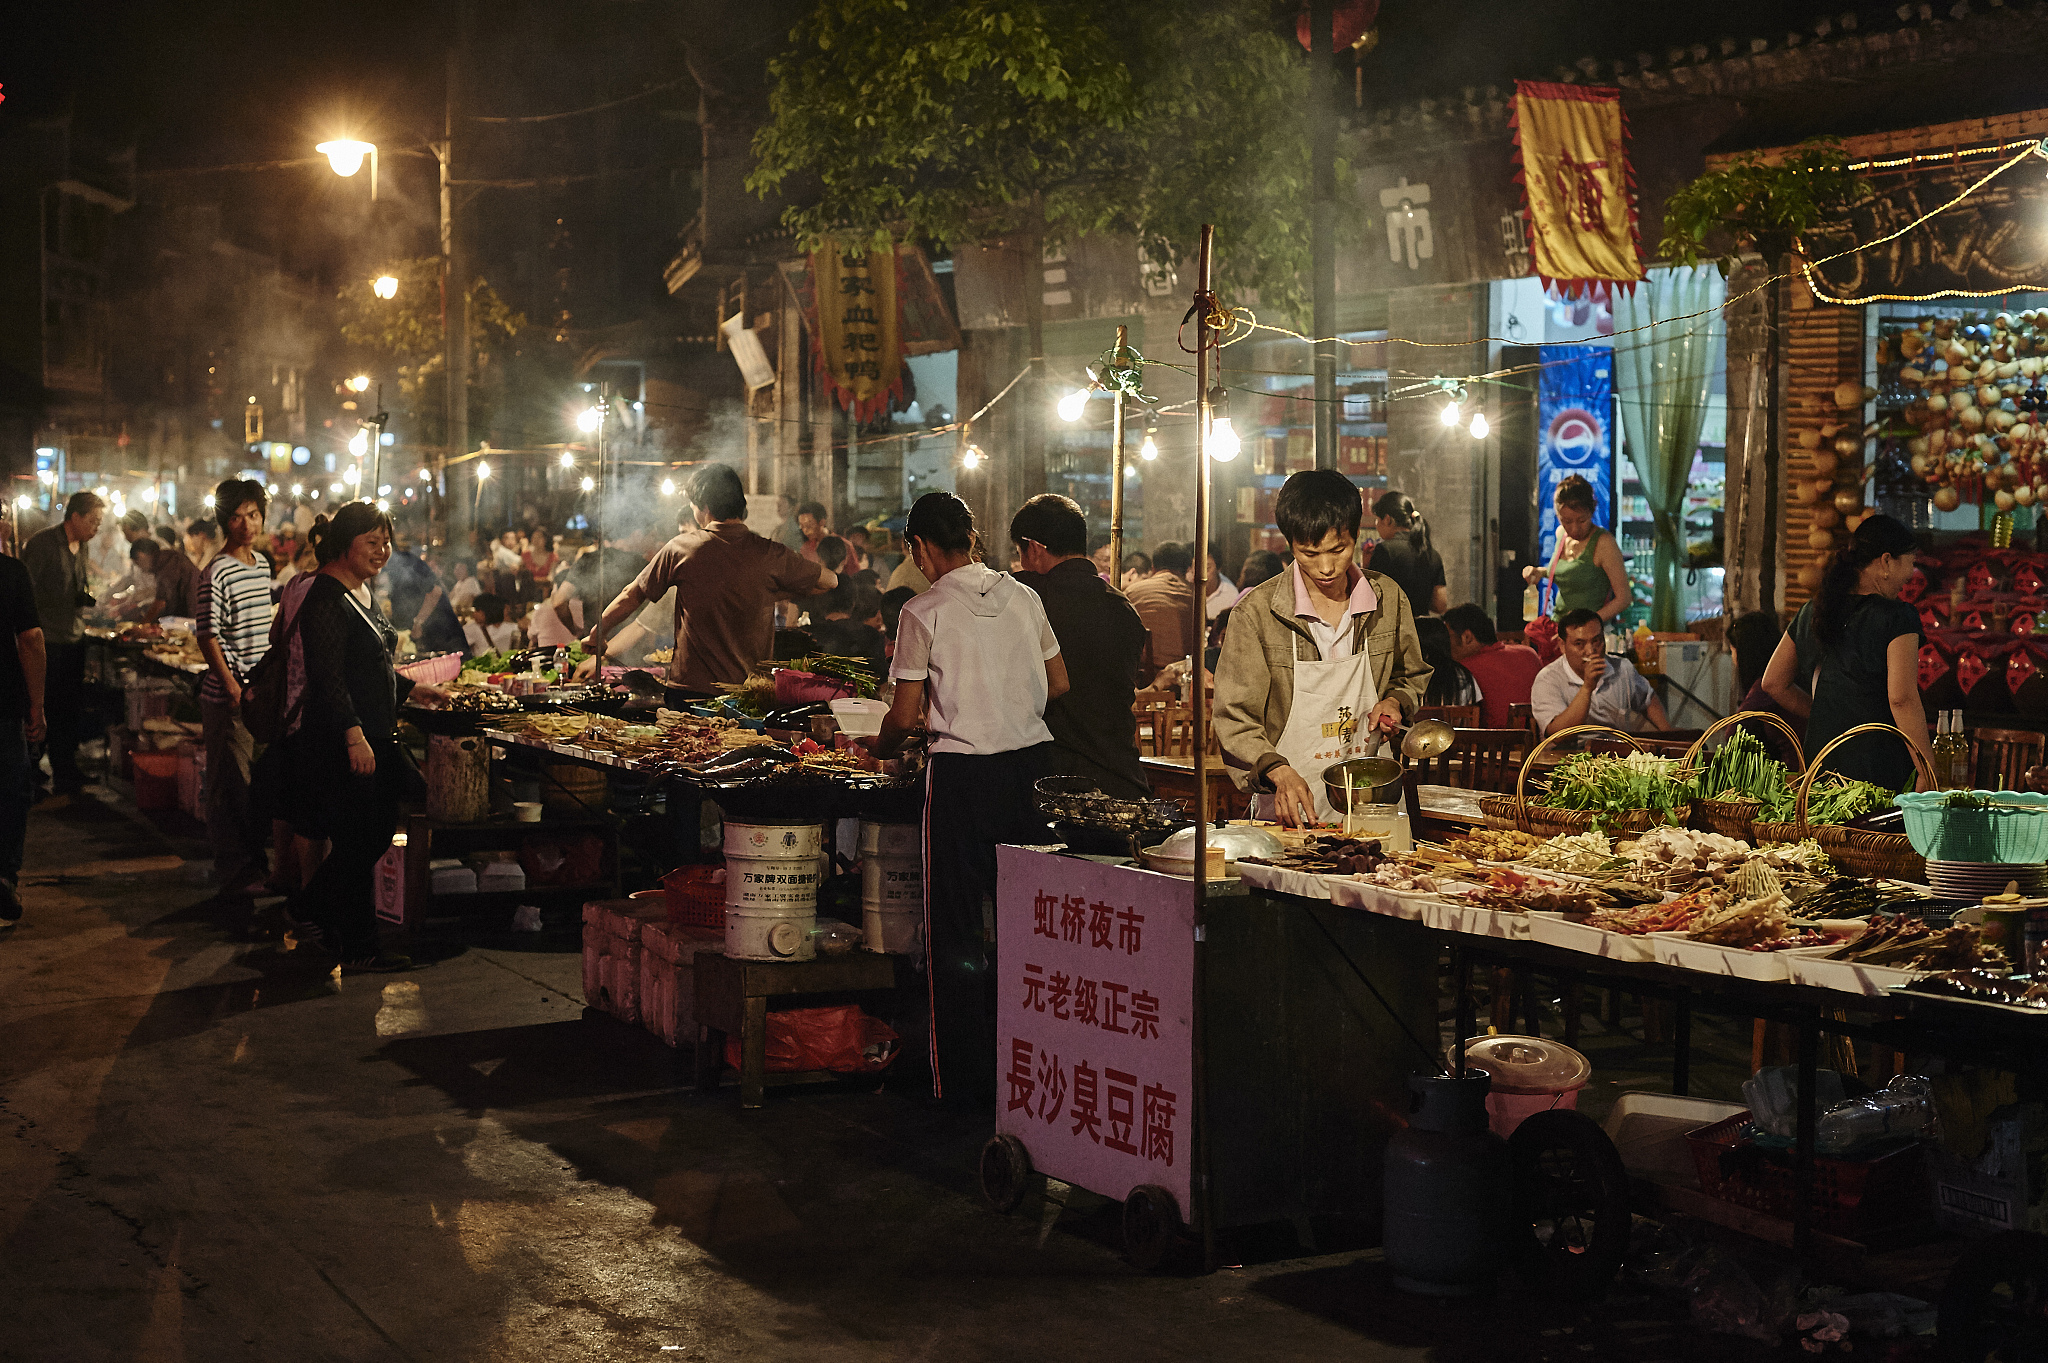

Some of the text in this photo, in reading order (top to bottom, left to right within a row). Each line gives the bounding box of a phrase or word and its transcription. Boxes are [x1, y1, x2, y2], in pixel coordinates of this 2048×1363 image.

[1033, 889, 1145, 955] 虹桥夜市
[1022, 963, 1160, 1040] 元老级正宗
[1006, 1037, 1177, 1167] 長沙臭豆腐
